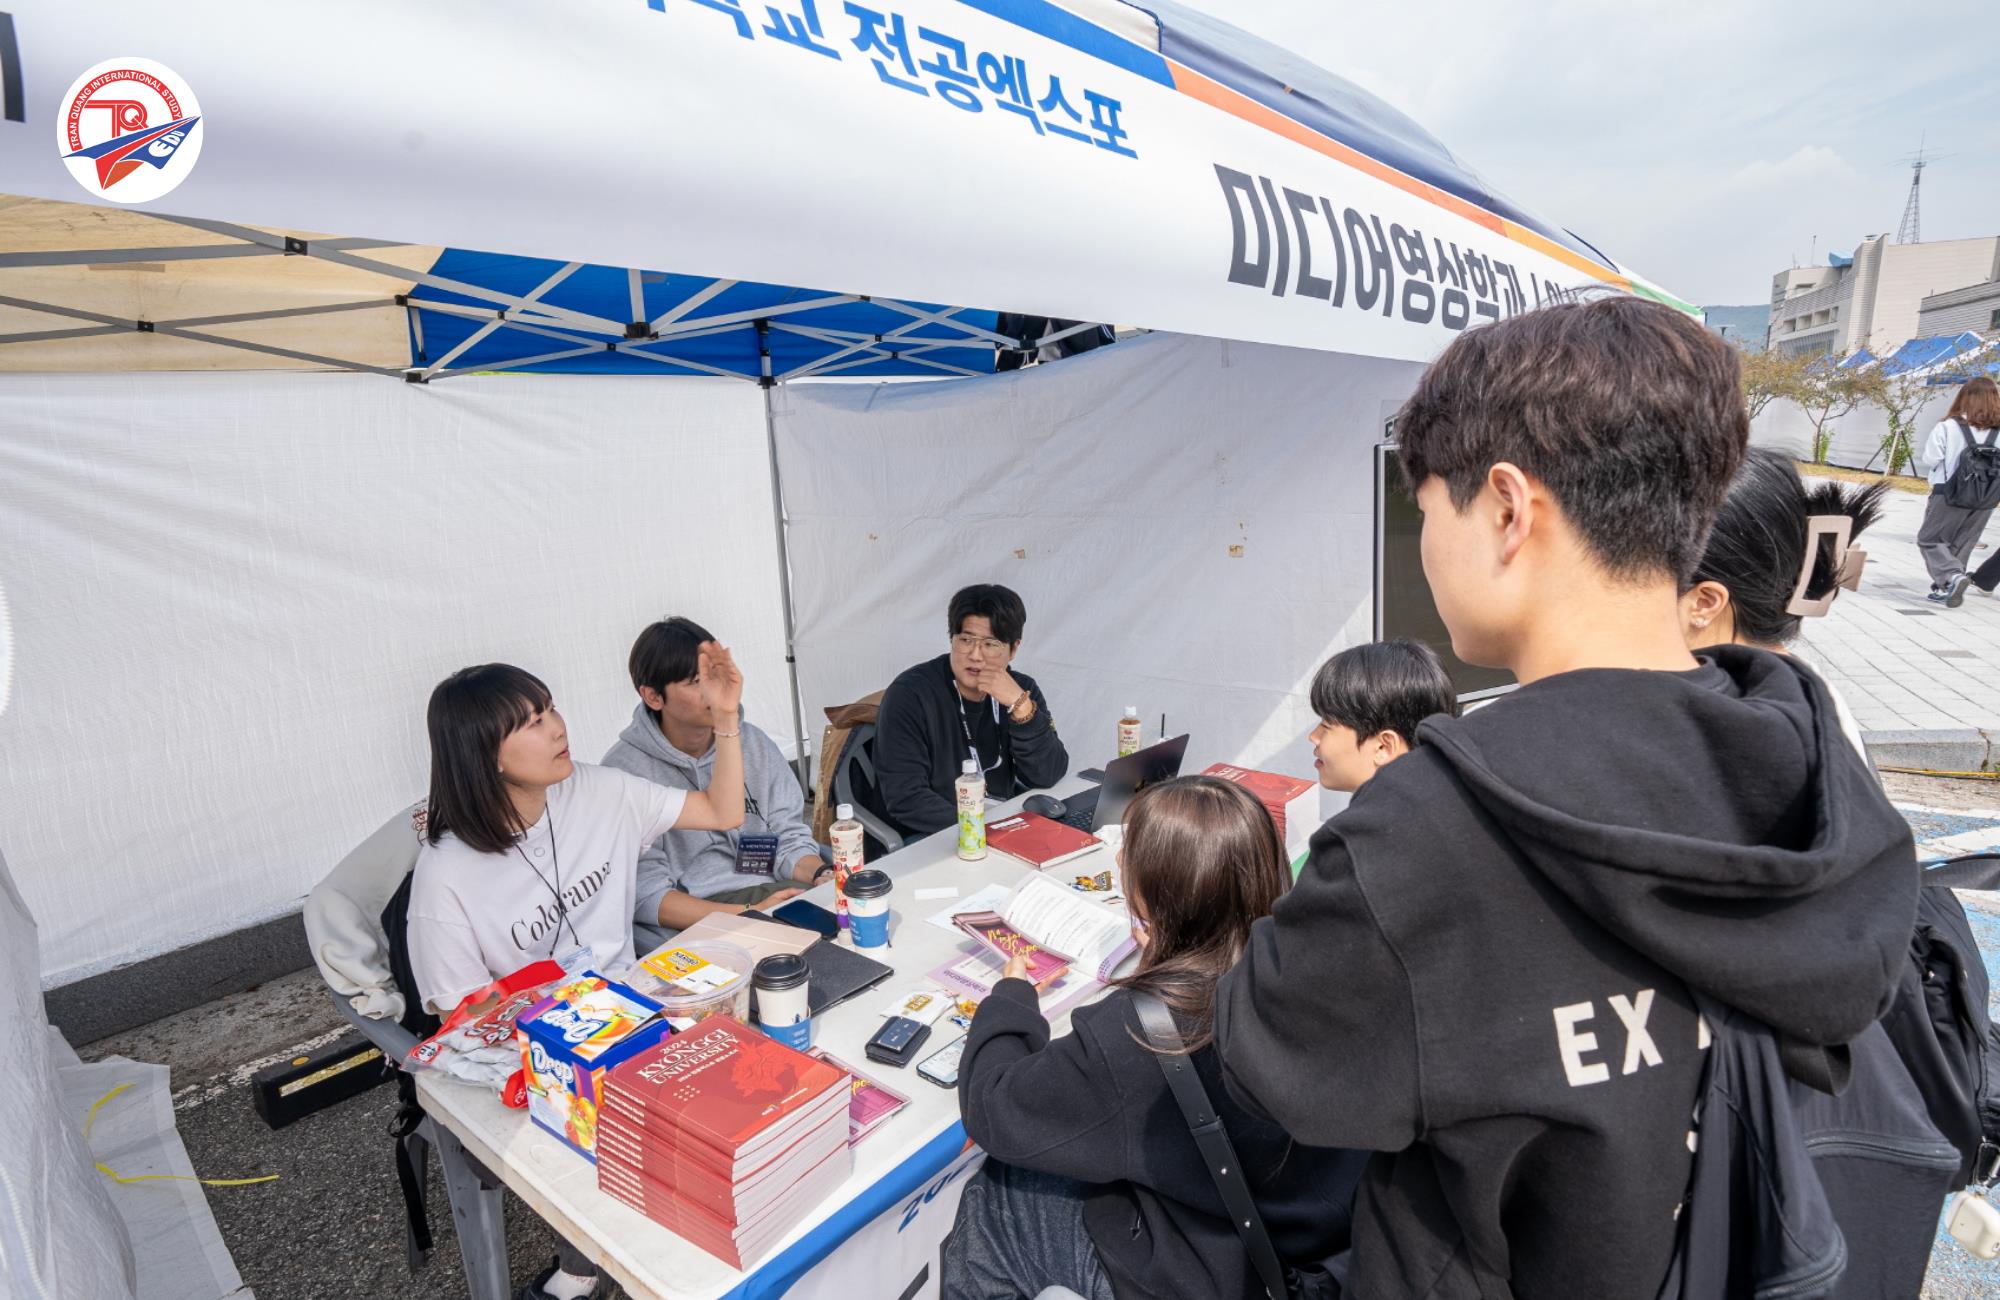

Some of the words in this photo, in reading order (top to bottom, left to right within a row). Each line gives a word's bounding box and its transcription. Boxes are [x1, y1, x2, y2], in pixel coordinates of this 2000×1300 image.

[843, 0, 1139, 160] 전공엑스포
[637, 1028, 730, 1079] KYONGGI
[651, 1035, 740, 1085] UNIVERSITY
